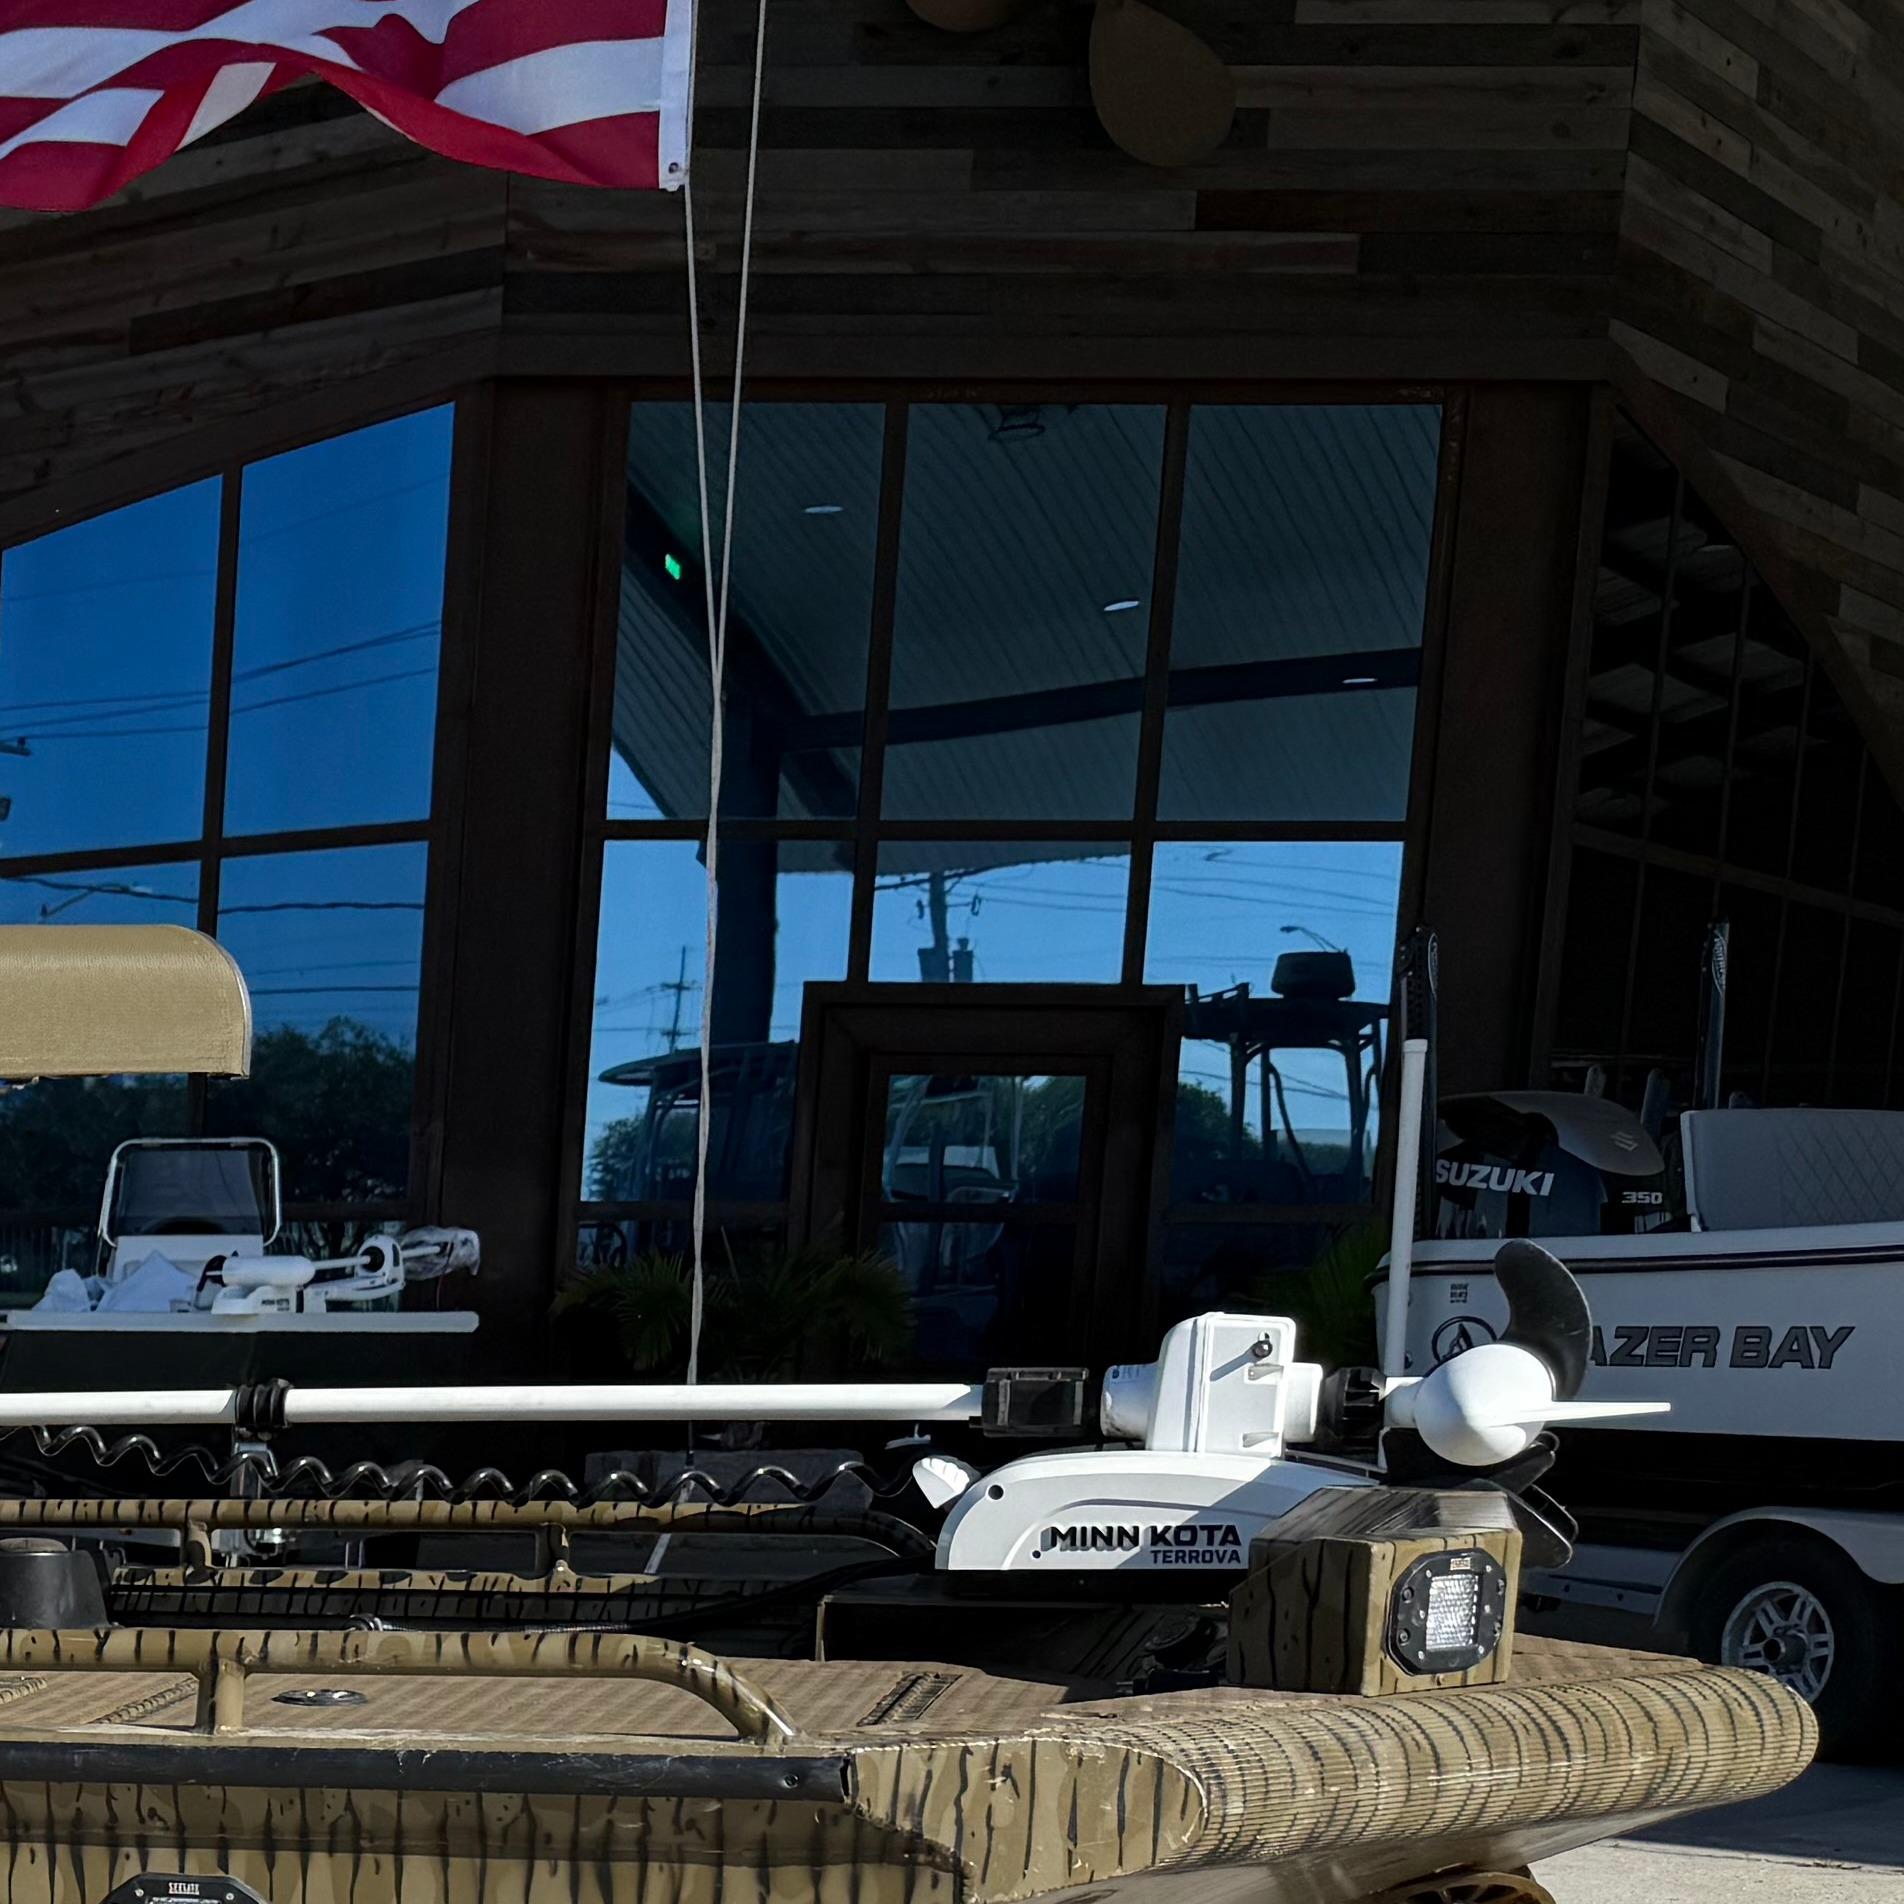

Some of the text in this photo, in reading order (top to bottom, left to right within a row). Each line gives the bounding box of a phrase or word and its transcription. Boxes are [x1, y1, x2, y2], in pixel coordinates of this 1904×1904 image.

[1435, 1158, 1556, 1198] SUZUKI
[1621, 1191, 1663, 1205] 350
[1728, 1326, 1857, 1369] BAY
[1047, 1524, 1242, 1549] MINN KOTA
[1150, 1550, 1242, 1564] TERROVA
